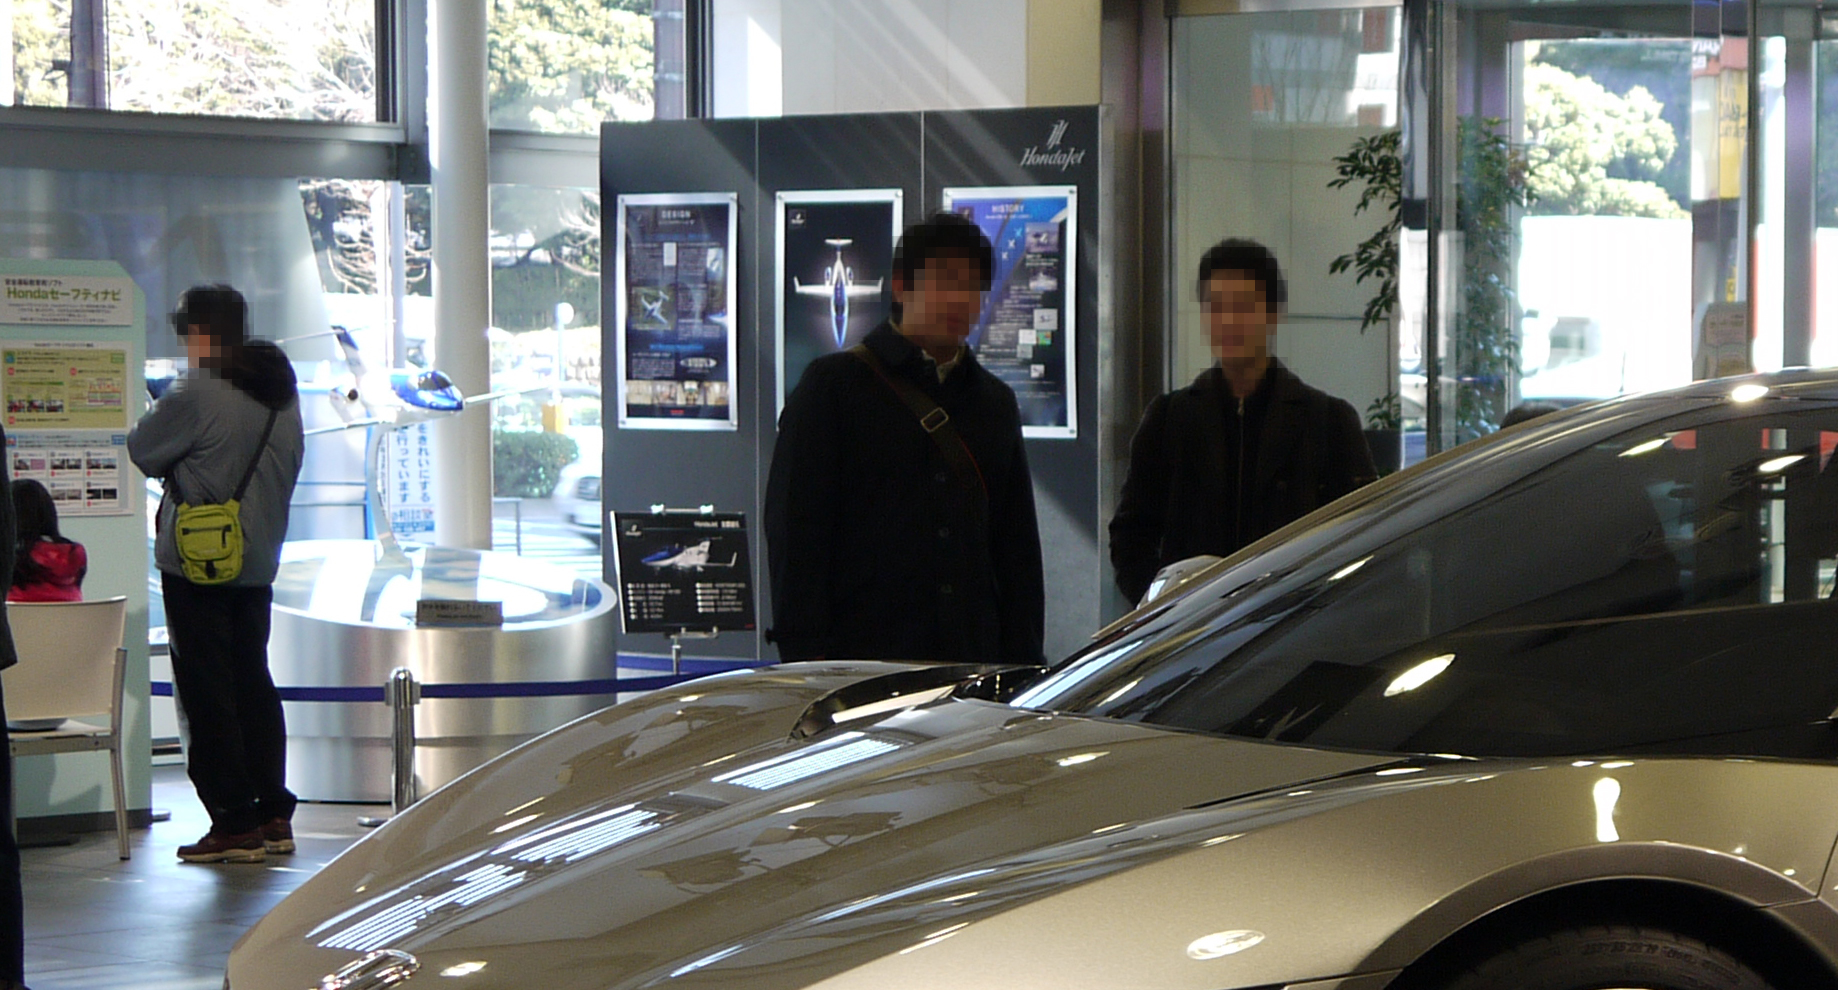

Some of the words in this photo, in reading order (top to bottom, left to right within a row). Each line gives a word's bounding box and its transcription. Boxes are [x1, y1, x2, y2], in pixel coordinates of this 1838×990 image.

[1020, 146, 1086, 171] HondaJet
[7, 287, 122, 302] Hondaセーフティナビ
